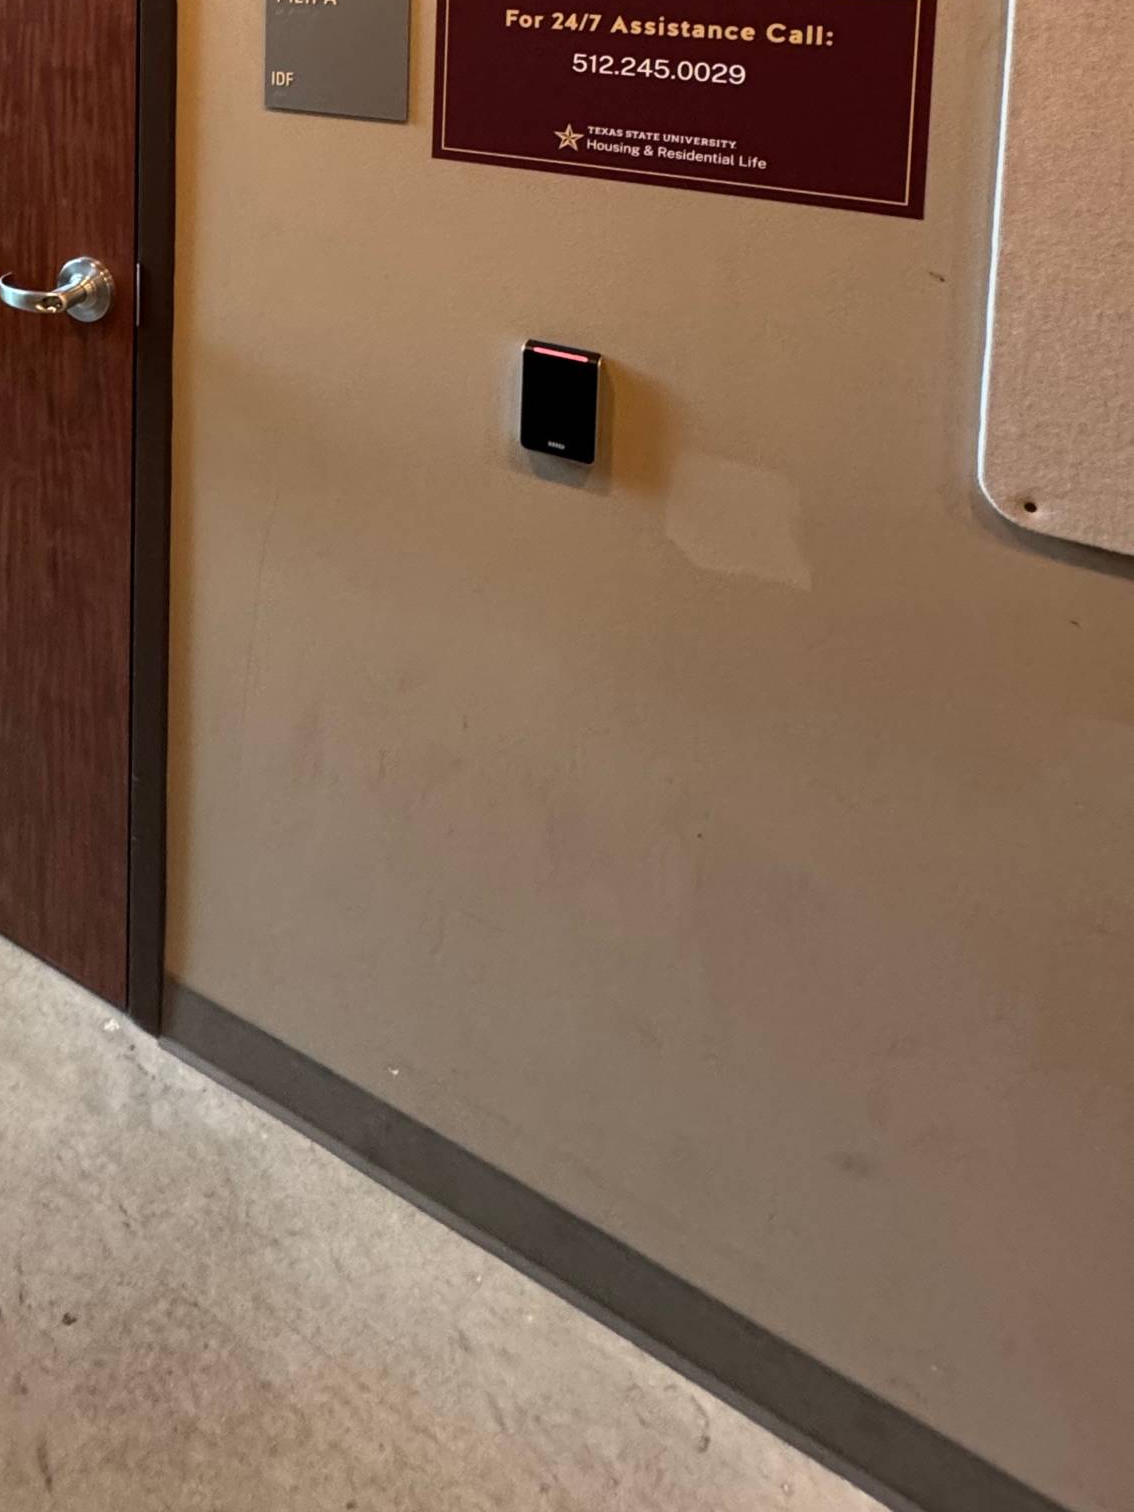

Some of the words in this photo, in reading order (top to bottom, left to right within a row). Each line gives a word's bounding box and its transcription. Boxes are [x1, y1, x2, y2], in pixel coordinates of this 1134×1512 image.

[505, 9, 544, 29] For
[551, 12, 602, 32] 24/7
[610, 15, 756, 41] Assistance
[766, 22, 834, 46] Call:
[271, 71, 294, 87] IDF
[572, 53, 746, 85] 512.245.0029
[587, 126, 624, 137] TEXAS
[625, 130, 660, 142] STATE
[662, 133, 737, 149] UNIVERSITY
[586, 139, 641, 157] Housing
[643, 145, 654, 157] &
[657, 146, 735, 167] Residential
[738, 155, 767, 170] Life
